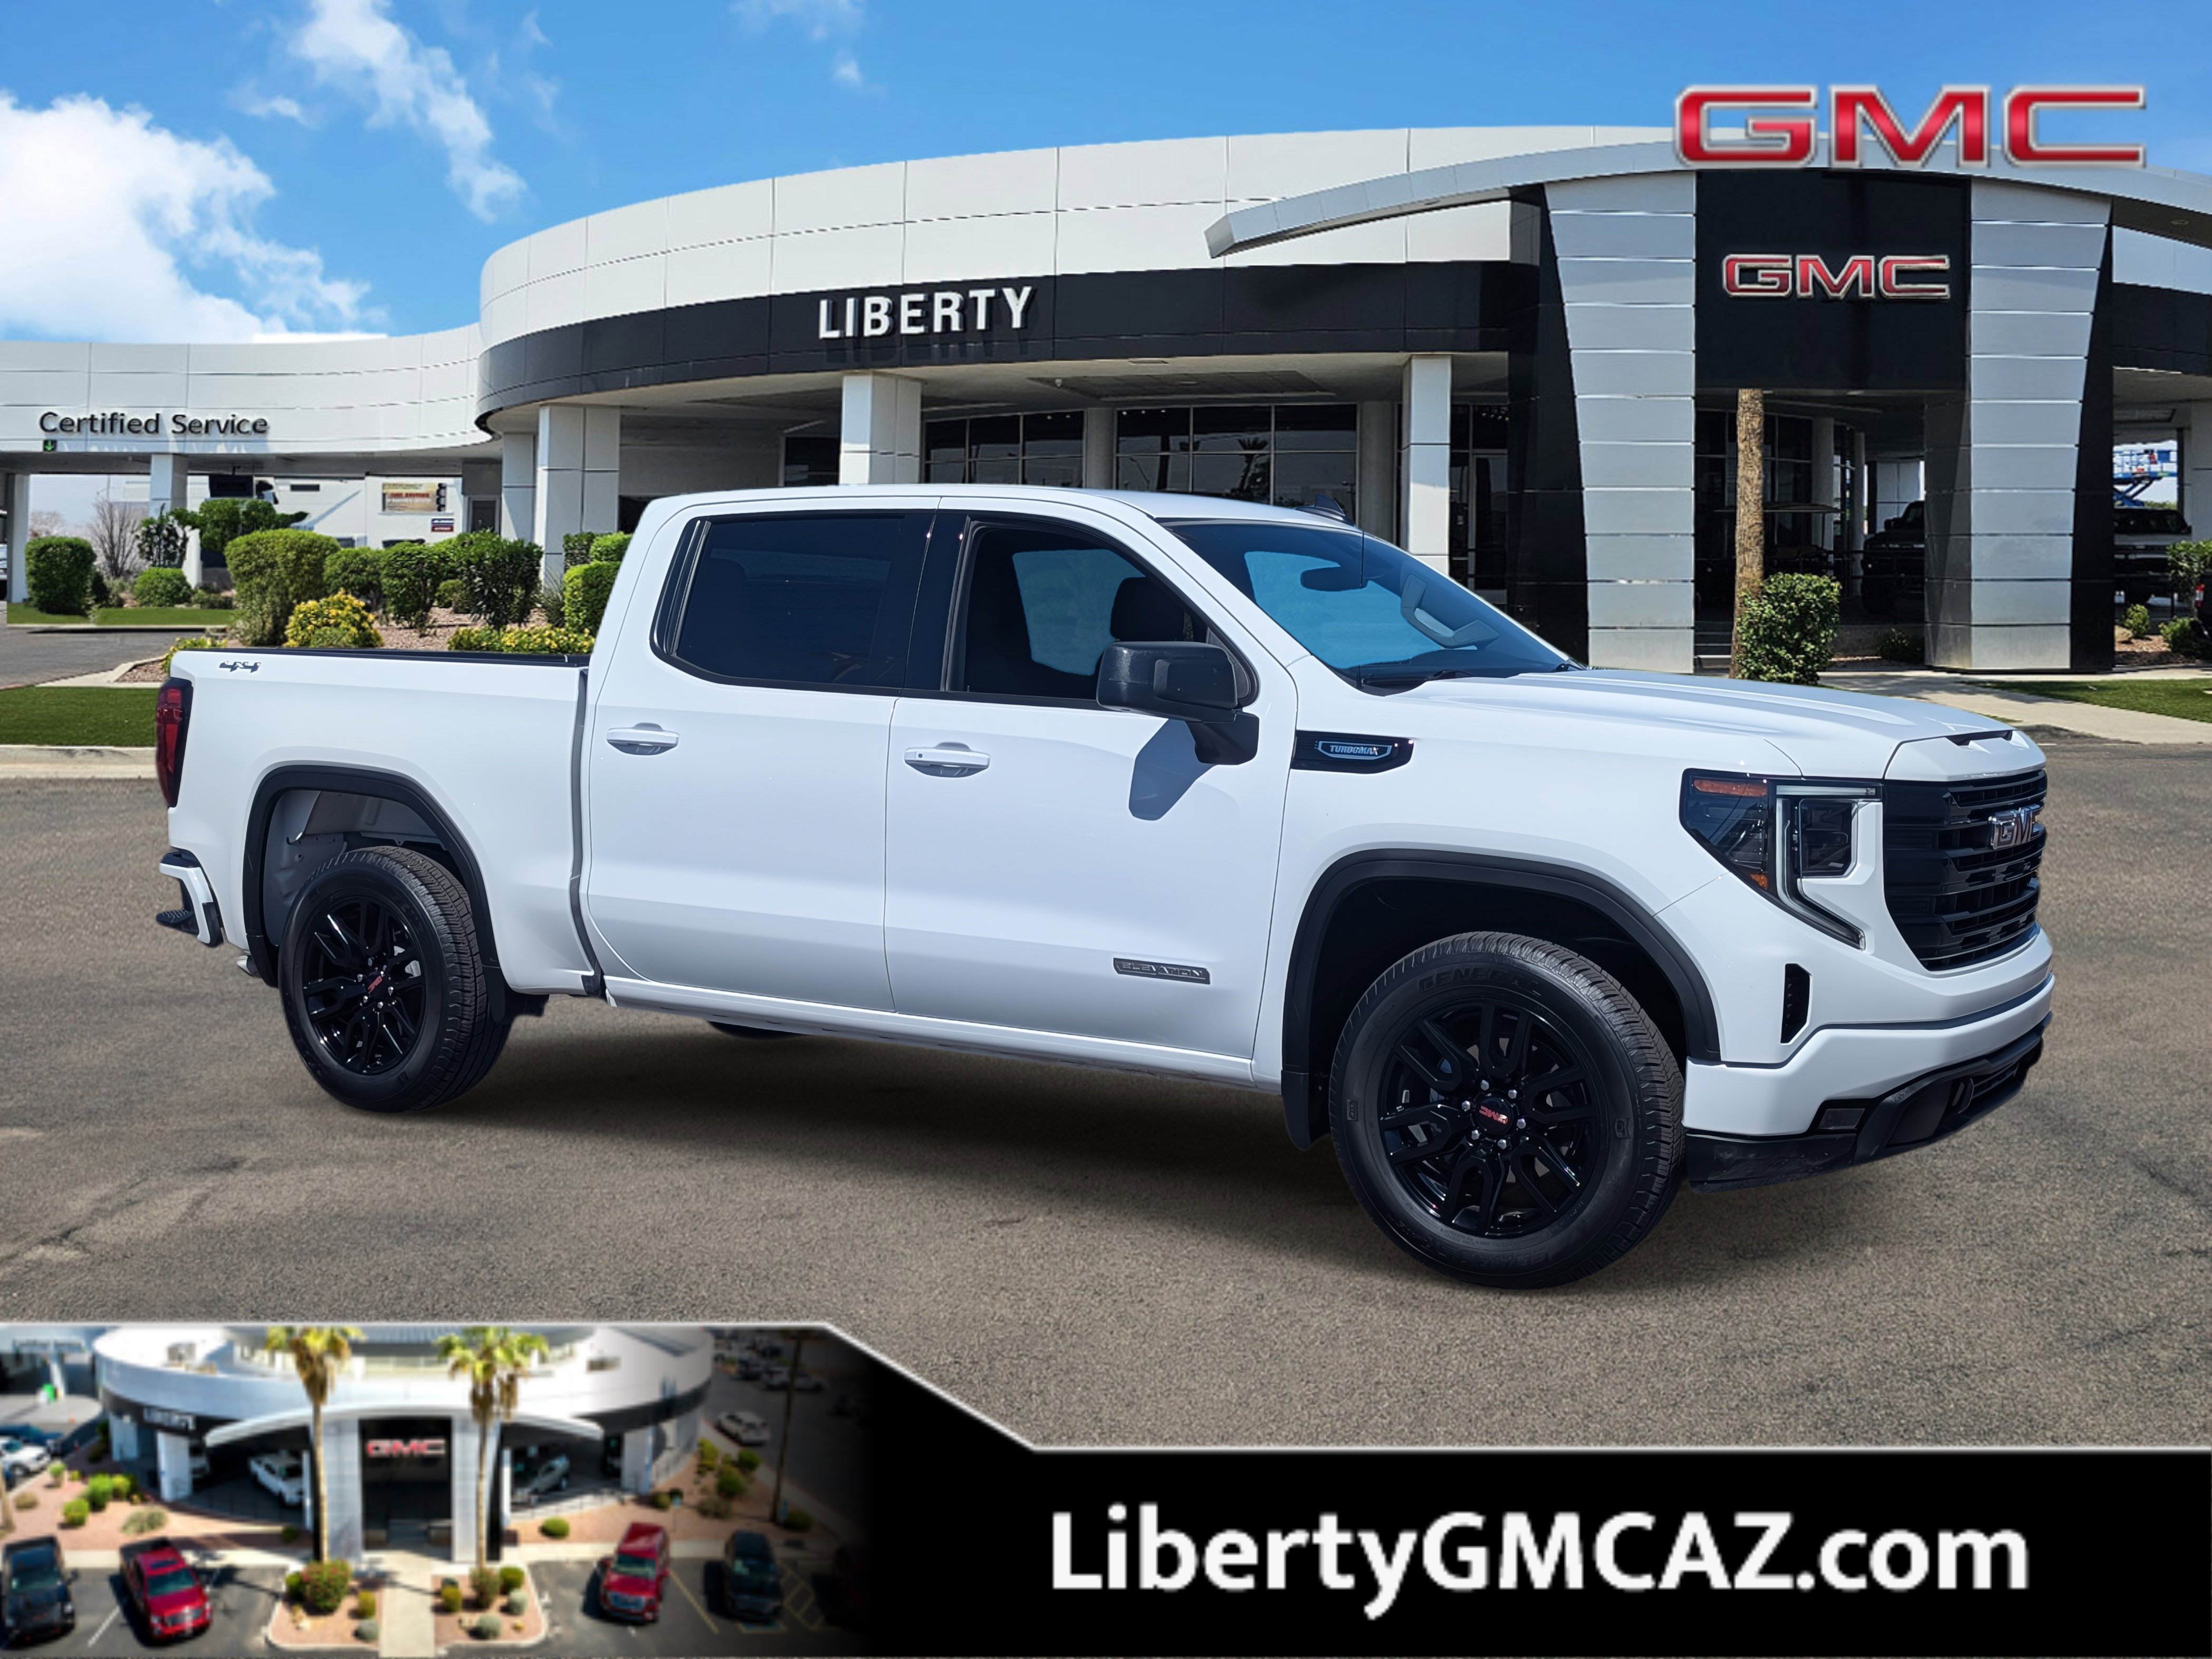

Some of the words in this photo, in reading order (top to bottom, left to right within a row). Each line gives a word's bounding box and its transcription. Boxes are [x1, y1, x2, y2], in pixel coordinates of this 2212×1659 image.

[1722, 253, 1950, 300] GMC
[819, 285, 1032, 339] LIBERTY
[39, 412, 160, 434] Certified
[171, 414, 268, 435] Service
